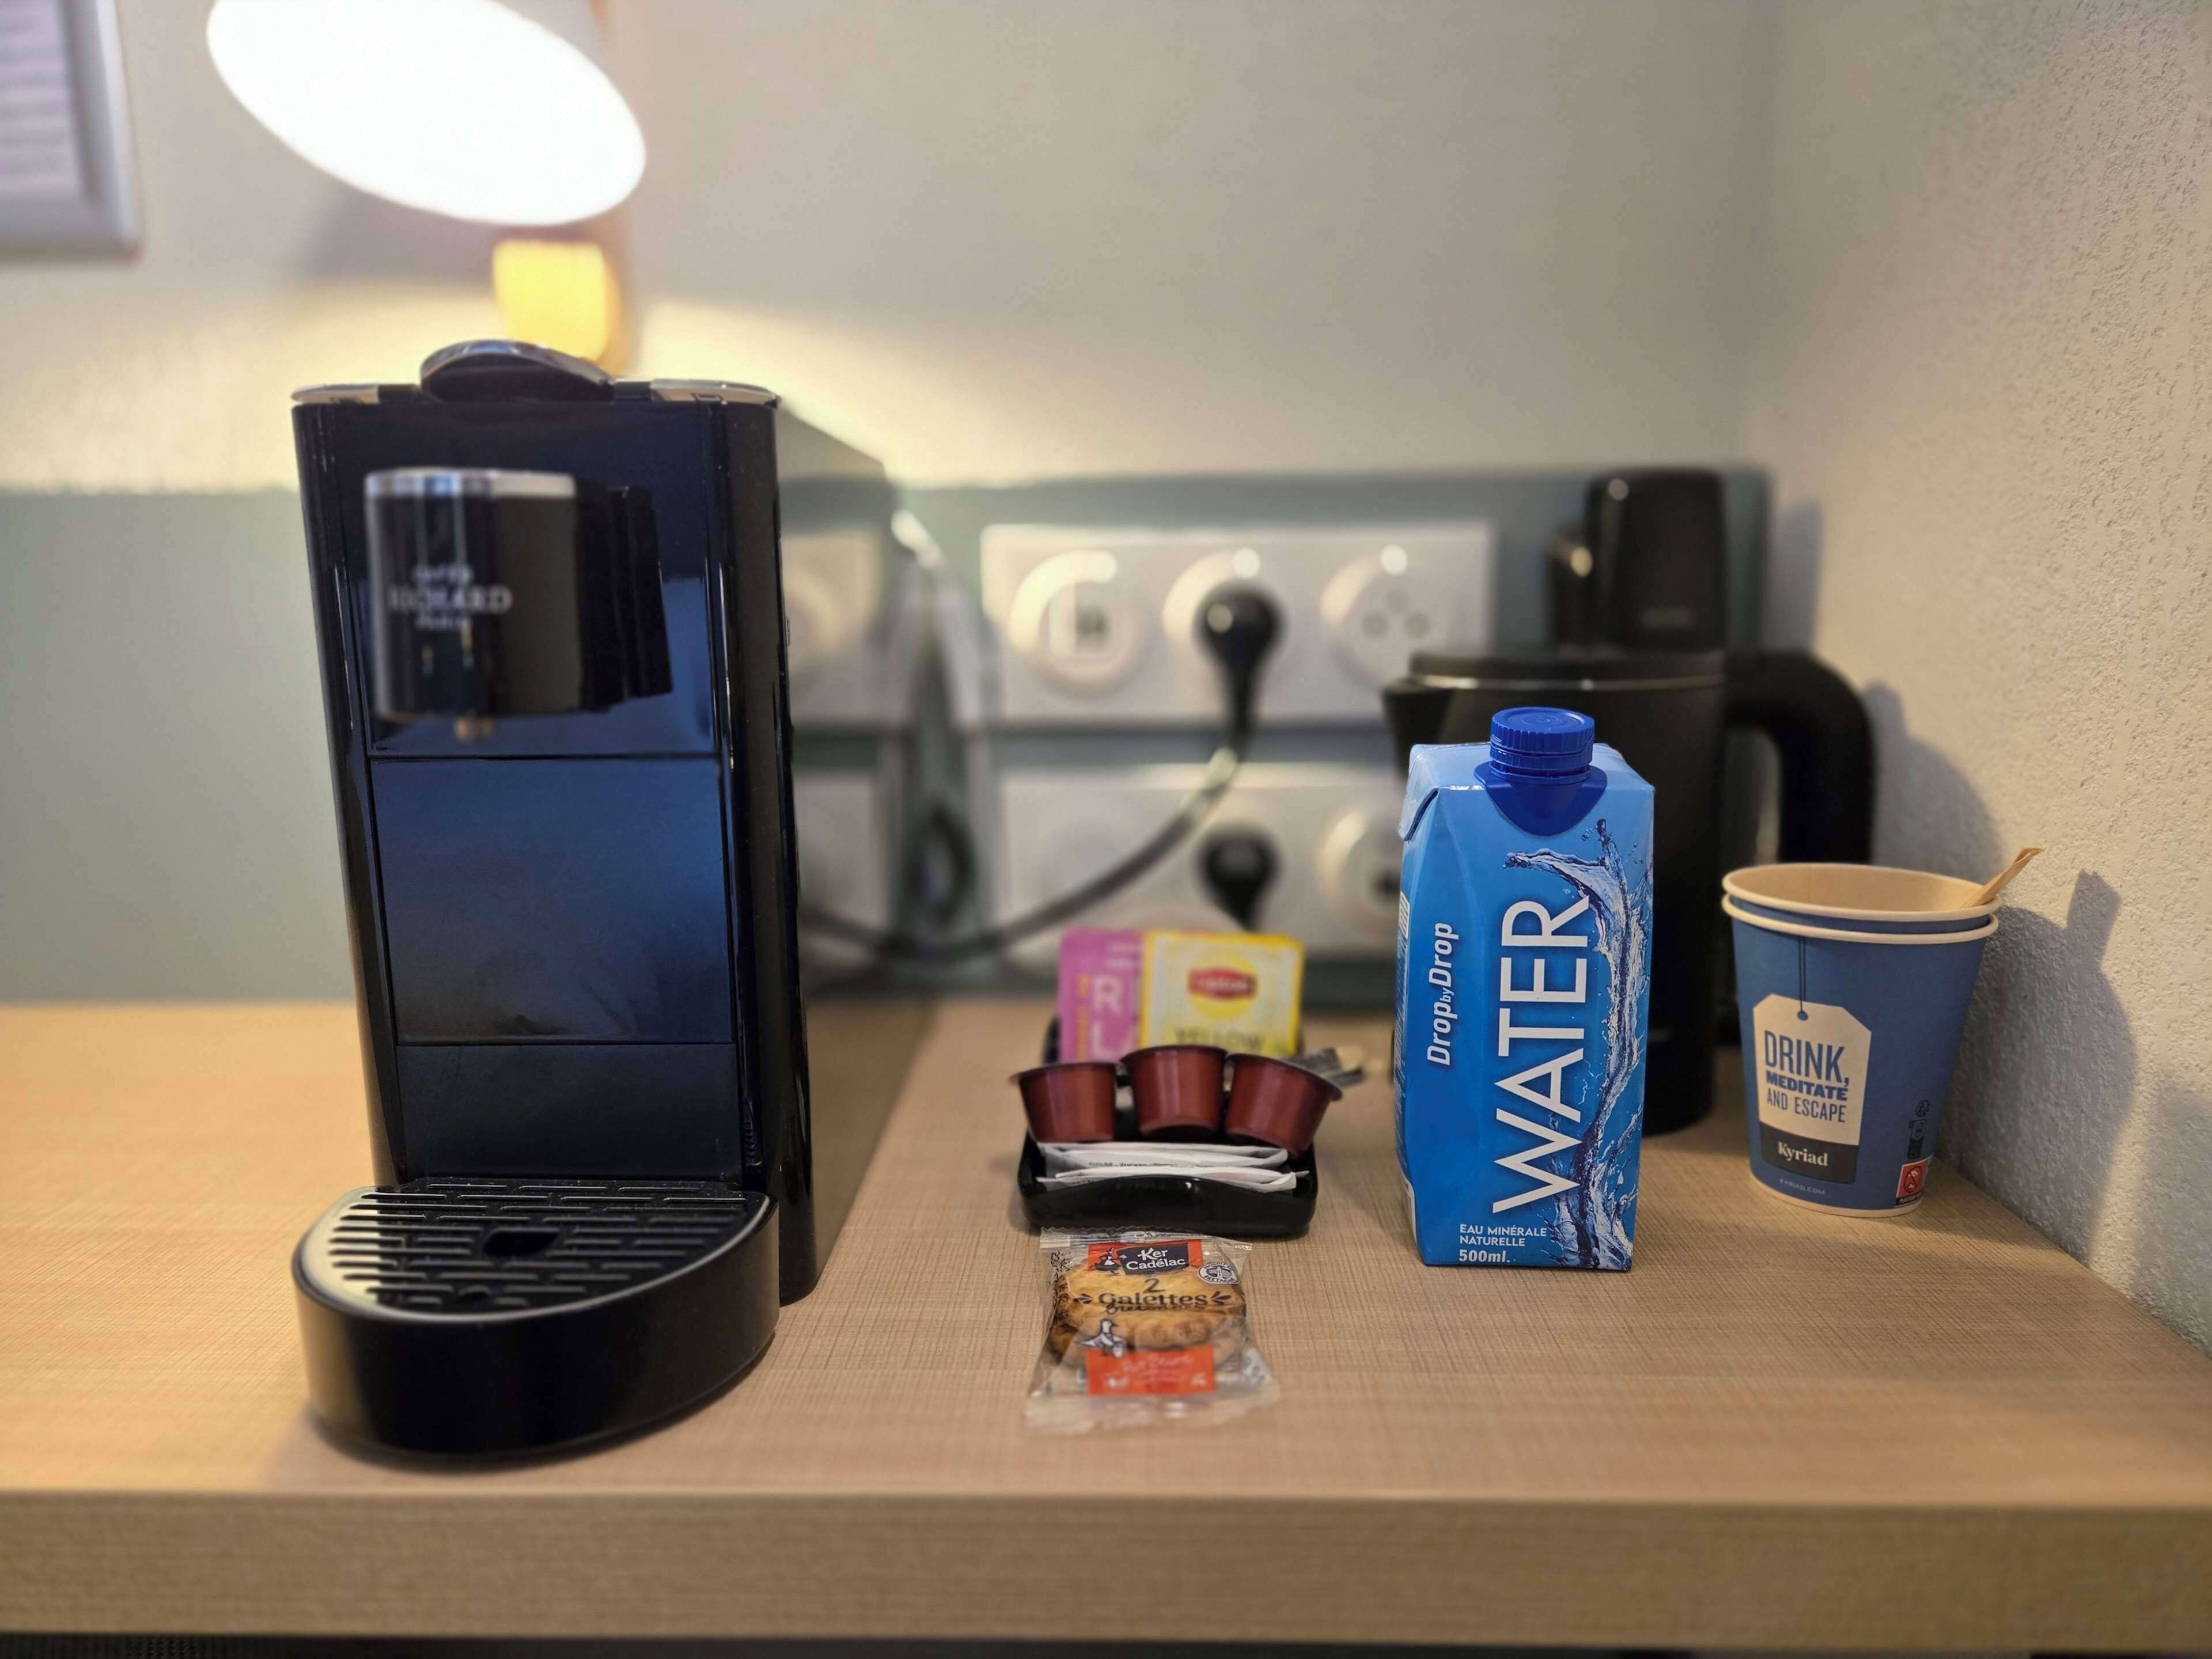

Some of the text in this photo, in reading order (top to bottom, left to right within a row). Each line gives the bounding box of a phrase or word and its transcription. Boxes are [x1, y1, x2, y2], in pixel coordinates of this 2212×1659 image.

[1429, 922, 1459, 987] Drop
[1427, 1001, 1458, 1066] Drop
[1492, 895, 1589, 1213] WATER
[1764, 1029, 1850, 1088] DRINK,
[1766, 1070, 1849, 1101] MEDITATE
[1767, 1088, 1846, 1123] AND ESCAPE
[1777, 1141, 1828, 1166] Kyriad
[1459, 1224, 1547, 1237] EAU MINÉRALE
[1459, 1235, 1525, 1247] NATURELLE
[1126, 1258, 1186, 1271] Cadélac
[1138, 1248, 1168, 1260] Ker
[1143, 1278, 1165, 1293] 2
[1099, 1293, 1208, 1306] Galettes
